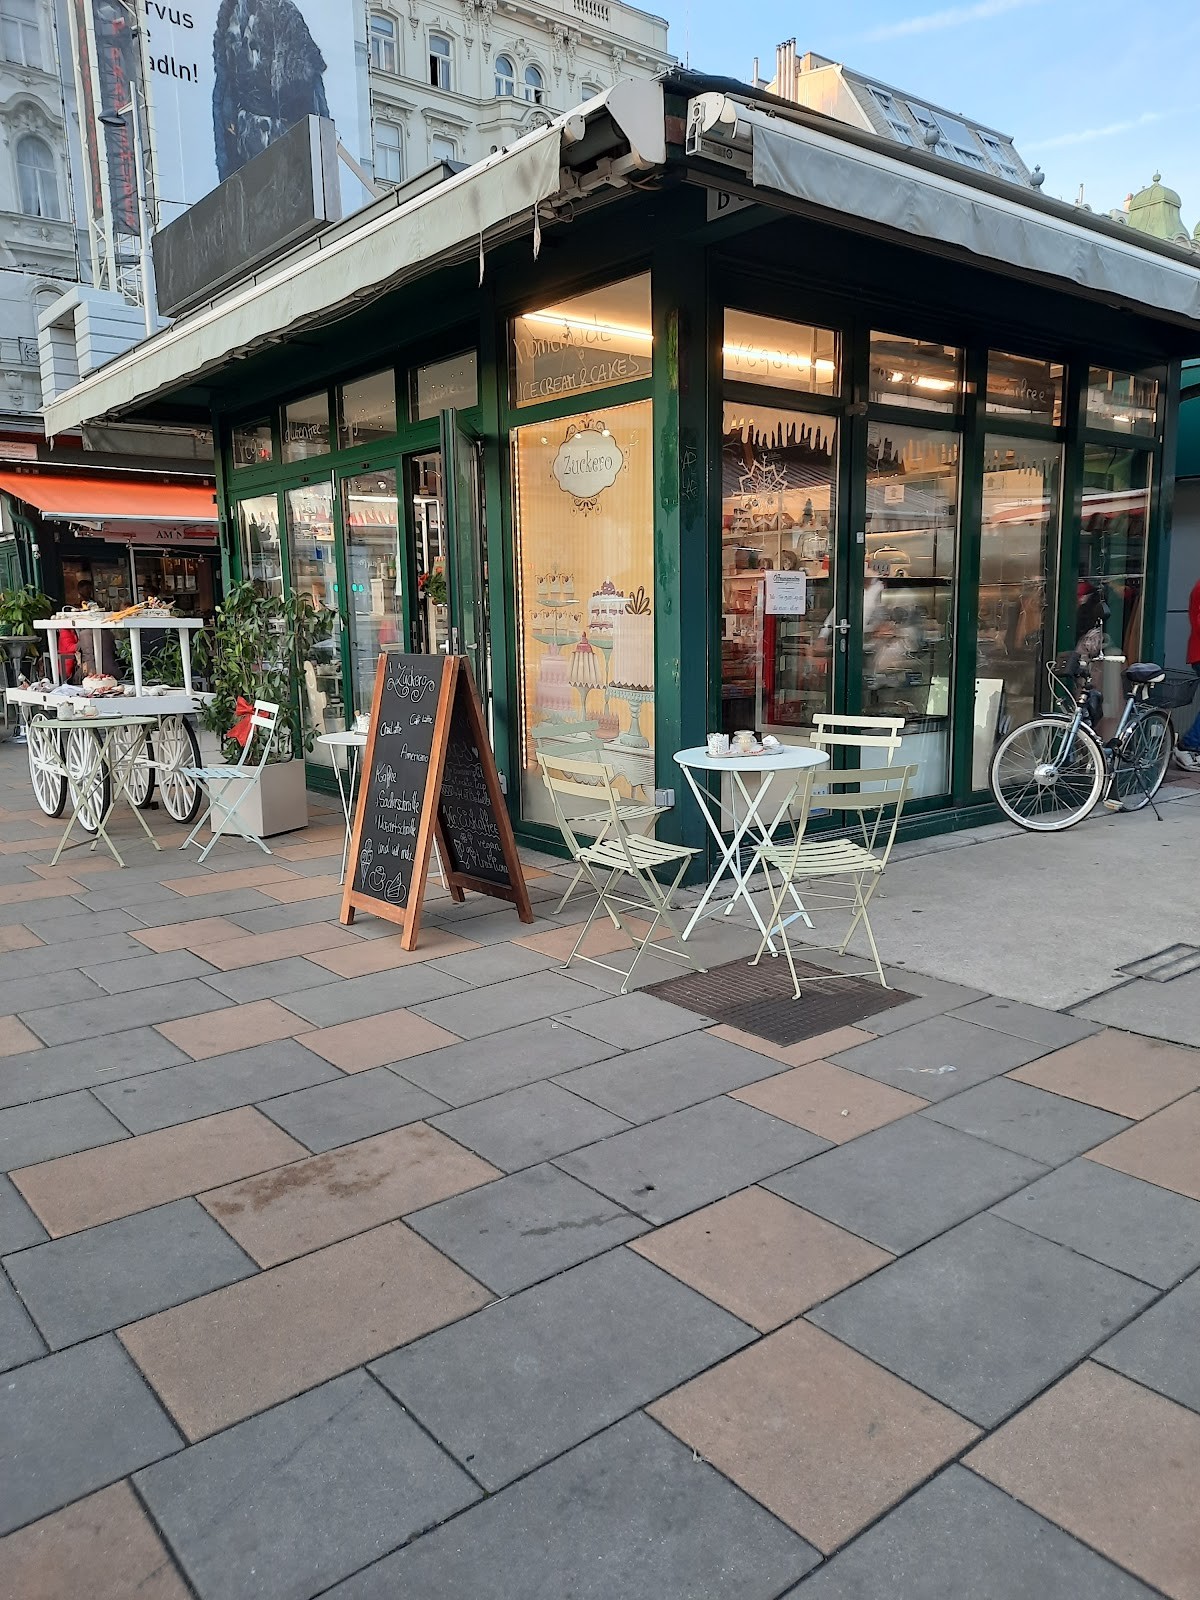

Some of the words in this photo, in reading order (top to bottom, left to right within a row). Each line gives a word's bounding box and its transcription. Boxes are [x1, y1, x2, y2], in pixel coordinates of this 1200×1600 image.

[145, 1, 194, 29] rvus
[149, 55, 198, 83] adln!
[590, 353, 640, 384] CAKES
[564, 450, 613, 475] Zuckero
[396, 663, 428, 688] Zuckero
[400, 742, 429, 763] Americano
[374, 763, 397, 789] Kaffee
